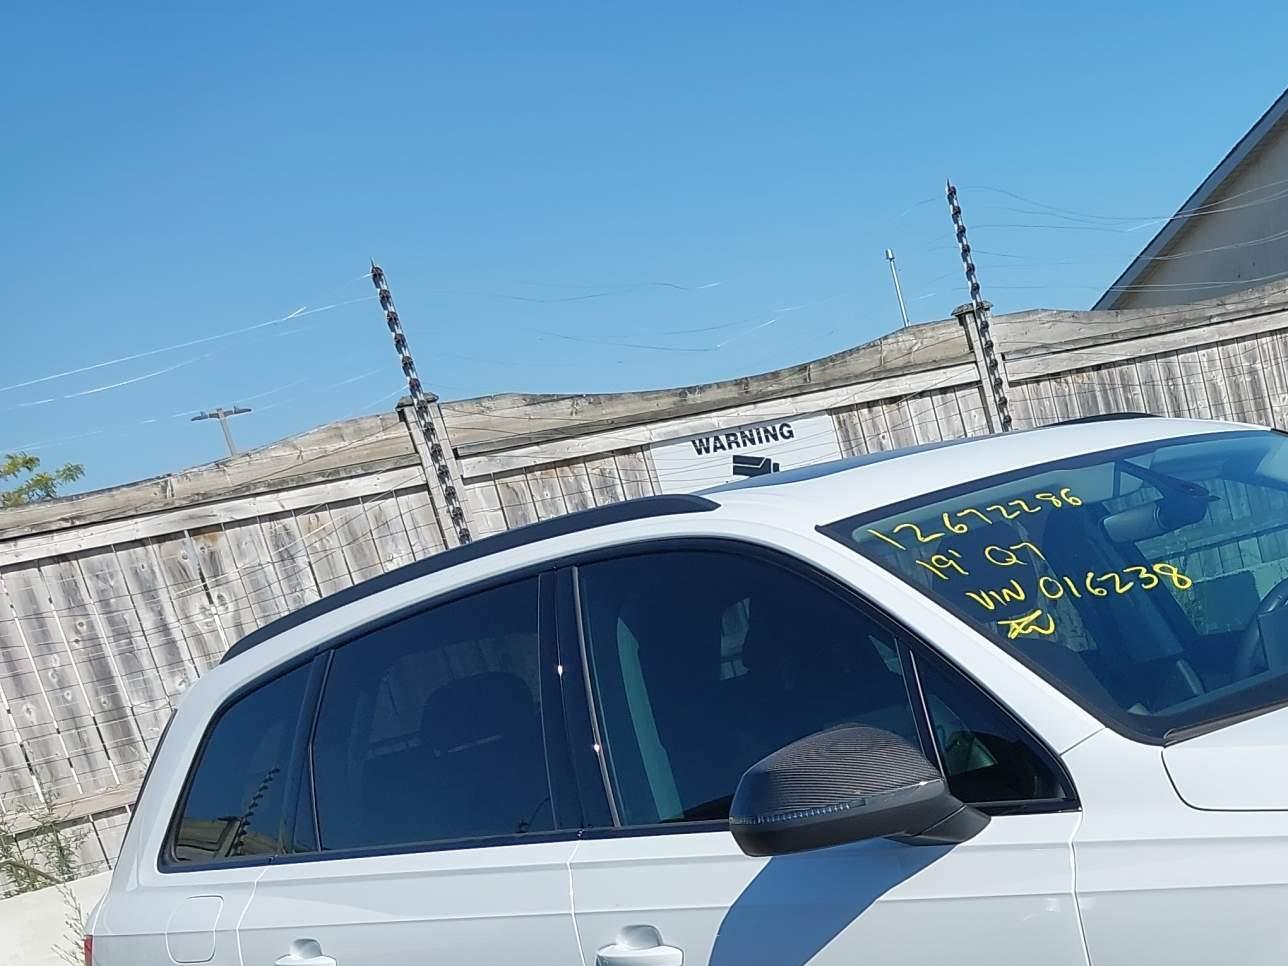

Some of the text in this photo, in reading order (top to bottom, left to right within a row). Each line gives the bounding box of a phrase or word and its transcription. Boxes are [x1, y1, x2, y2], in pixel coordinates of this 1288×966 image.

[691, 423, 794, 455] WARNING
[867, 488, 1083, 550] 12672286
[984, 542, 1046, 566] Q7
[965, 563, 1193, 610] VIN 016238
